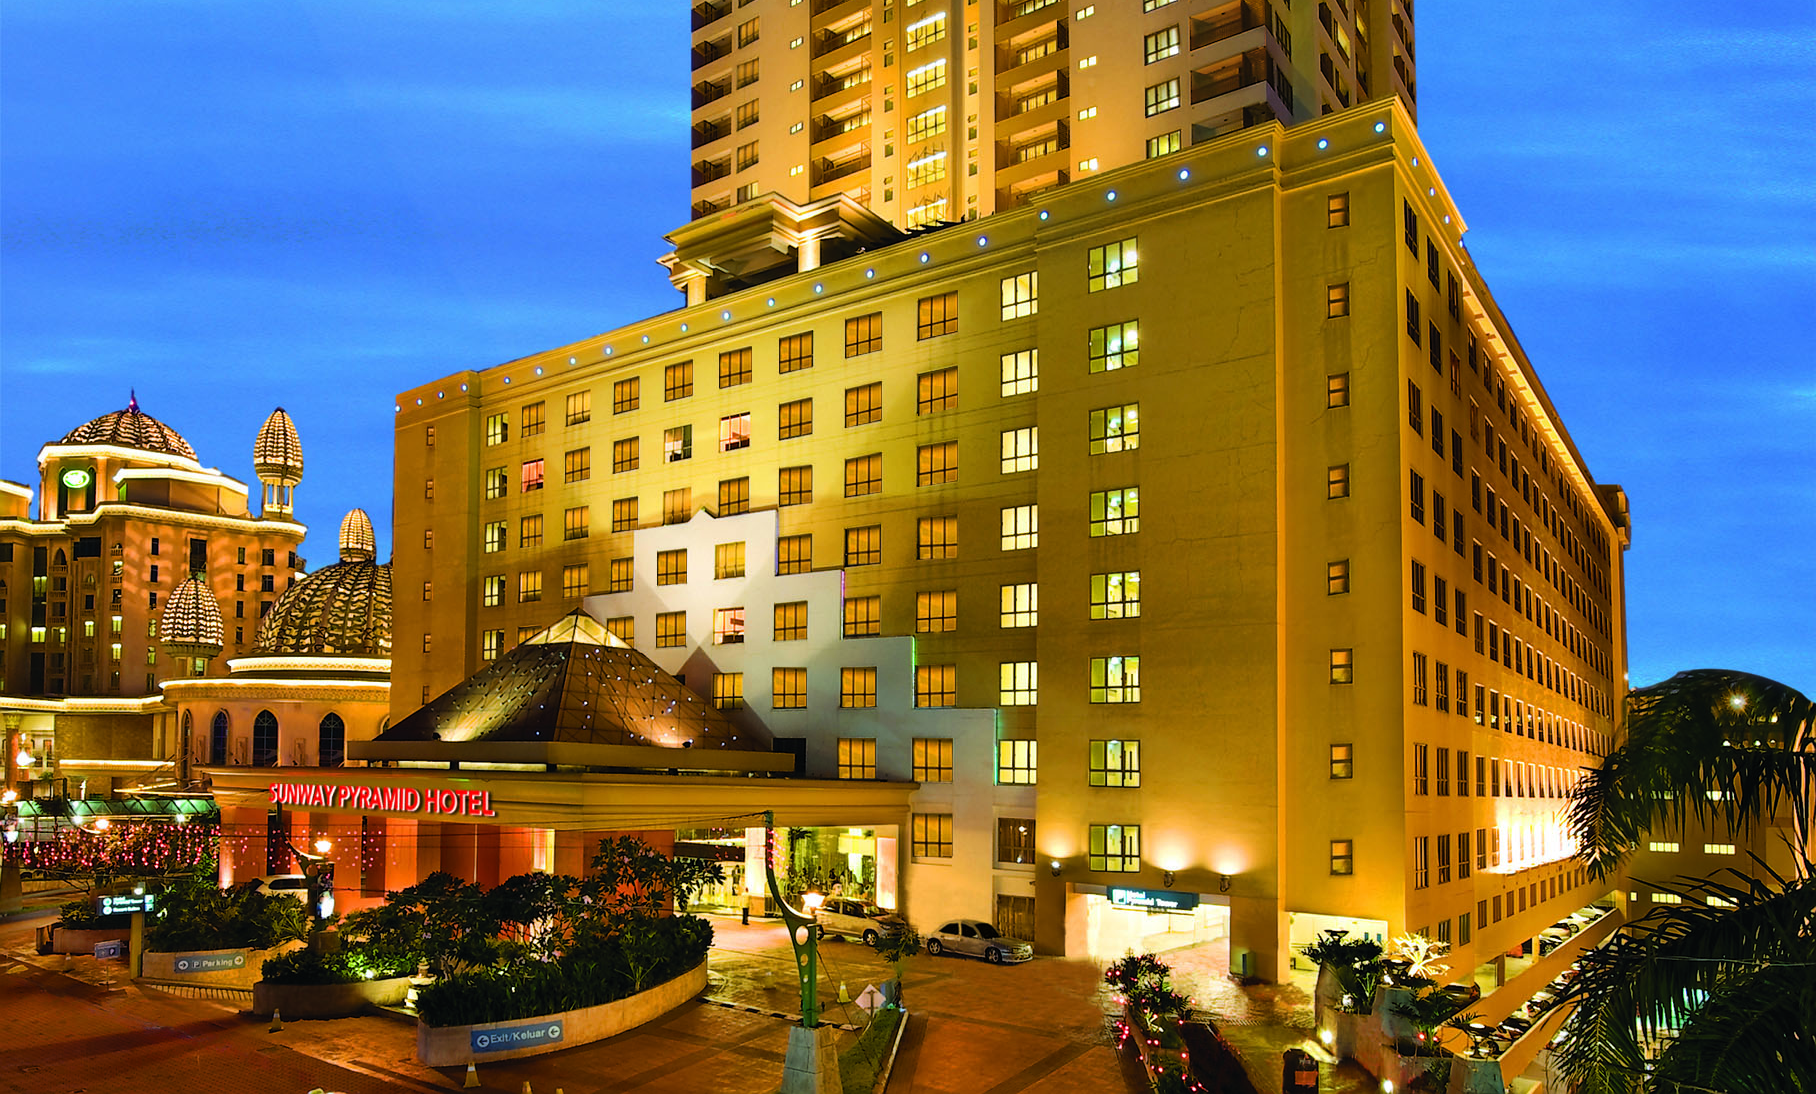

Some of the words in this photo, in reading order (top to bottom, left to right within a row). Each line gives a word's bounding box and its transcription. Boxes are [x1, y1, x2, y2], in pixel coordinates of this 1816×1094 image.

[268, 783, 336, 807] SUNWAY
[338, 785, 420, 813] PYRAMID
[424, 788, 495, 817] HOTEL
[202, 959, 233, 967] Parking
